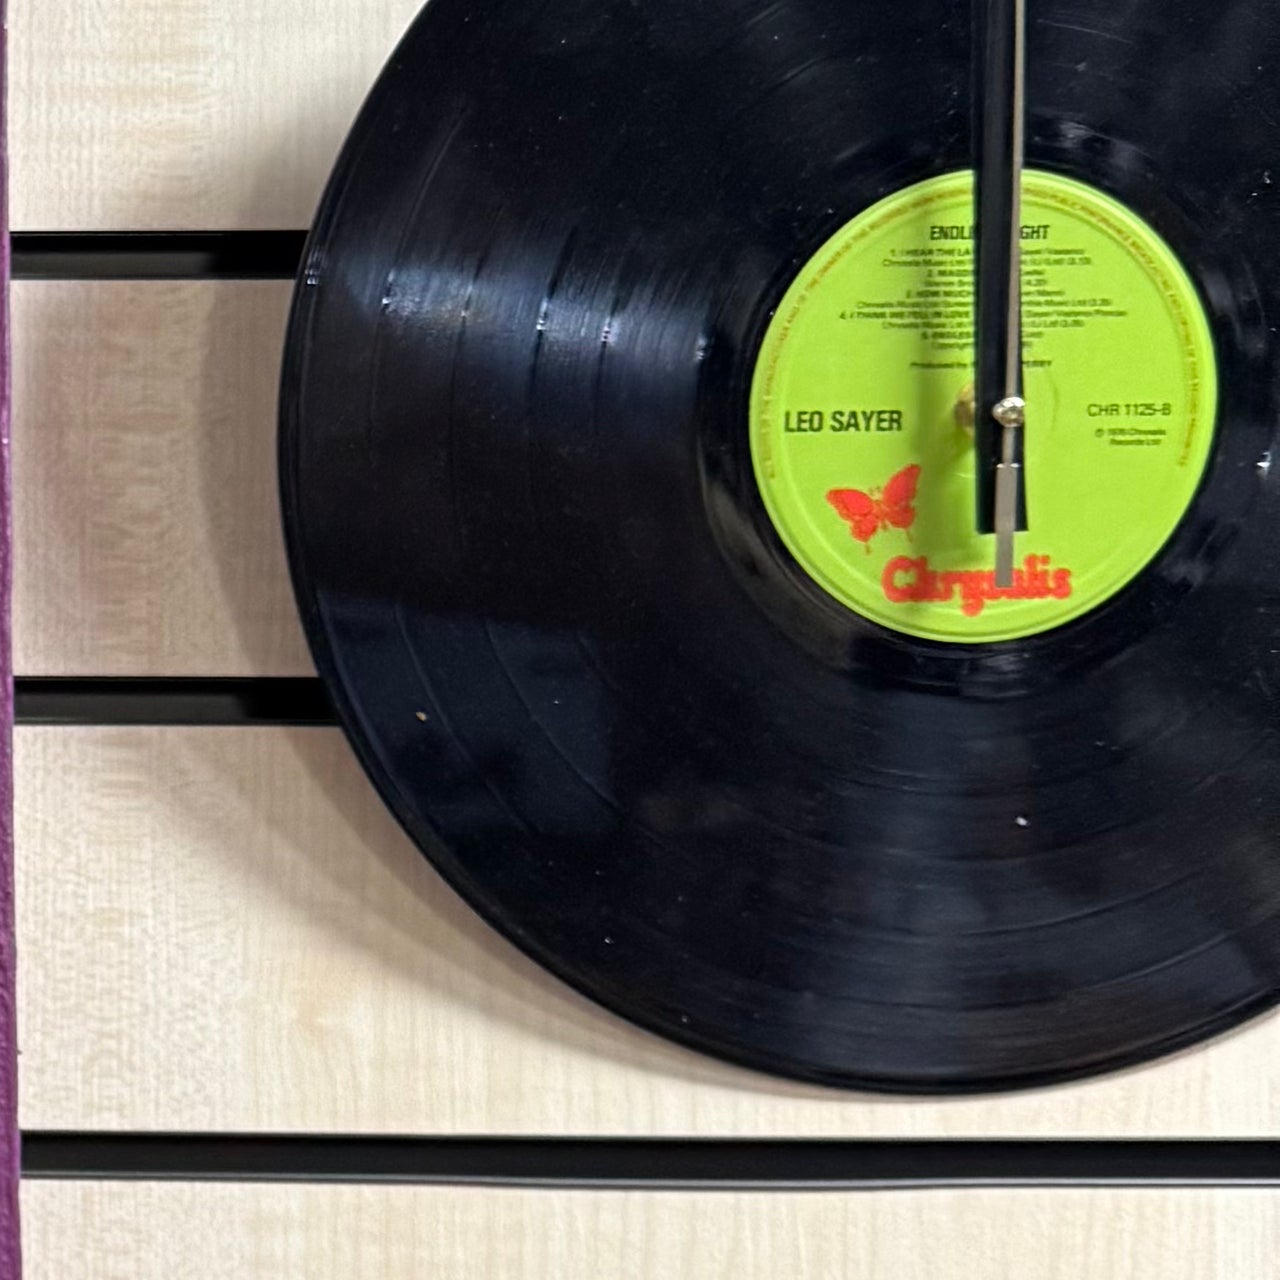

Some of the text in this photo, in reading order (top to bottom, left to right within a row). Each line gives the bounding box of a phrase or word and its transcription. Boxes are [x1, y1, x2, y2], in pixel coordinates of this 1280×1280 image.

[930, 224, 1050, 240] ENDL GHT
[1087, 403, 1120, 417] CHR
[784, 410, 903, 433] LEO SAYER
